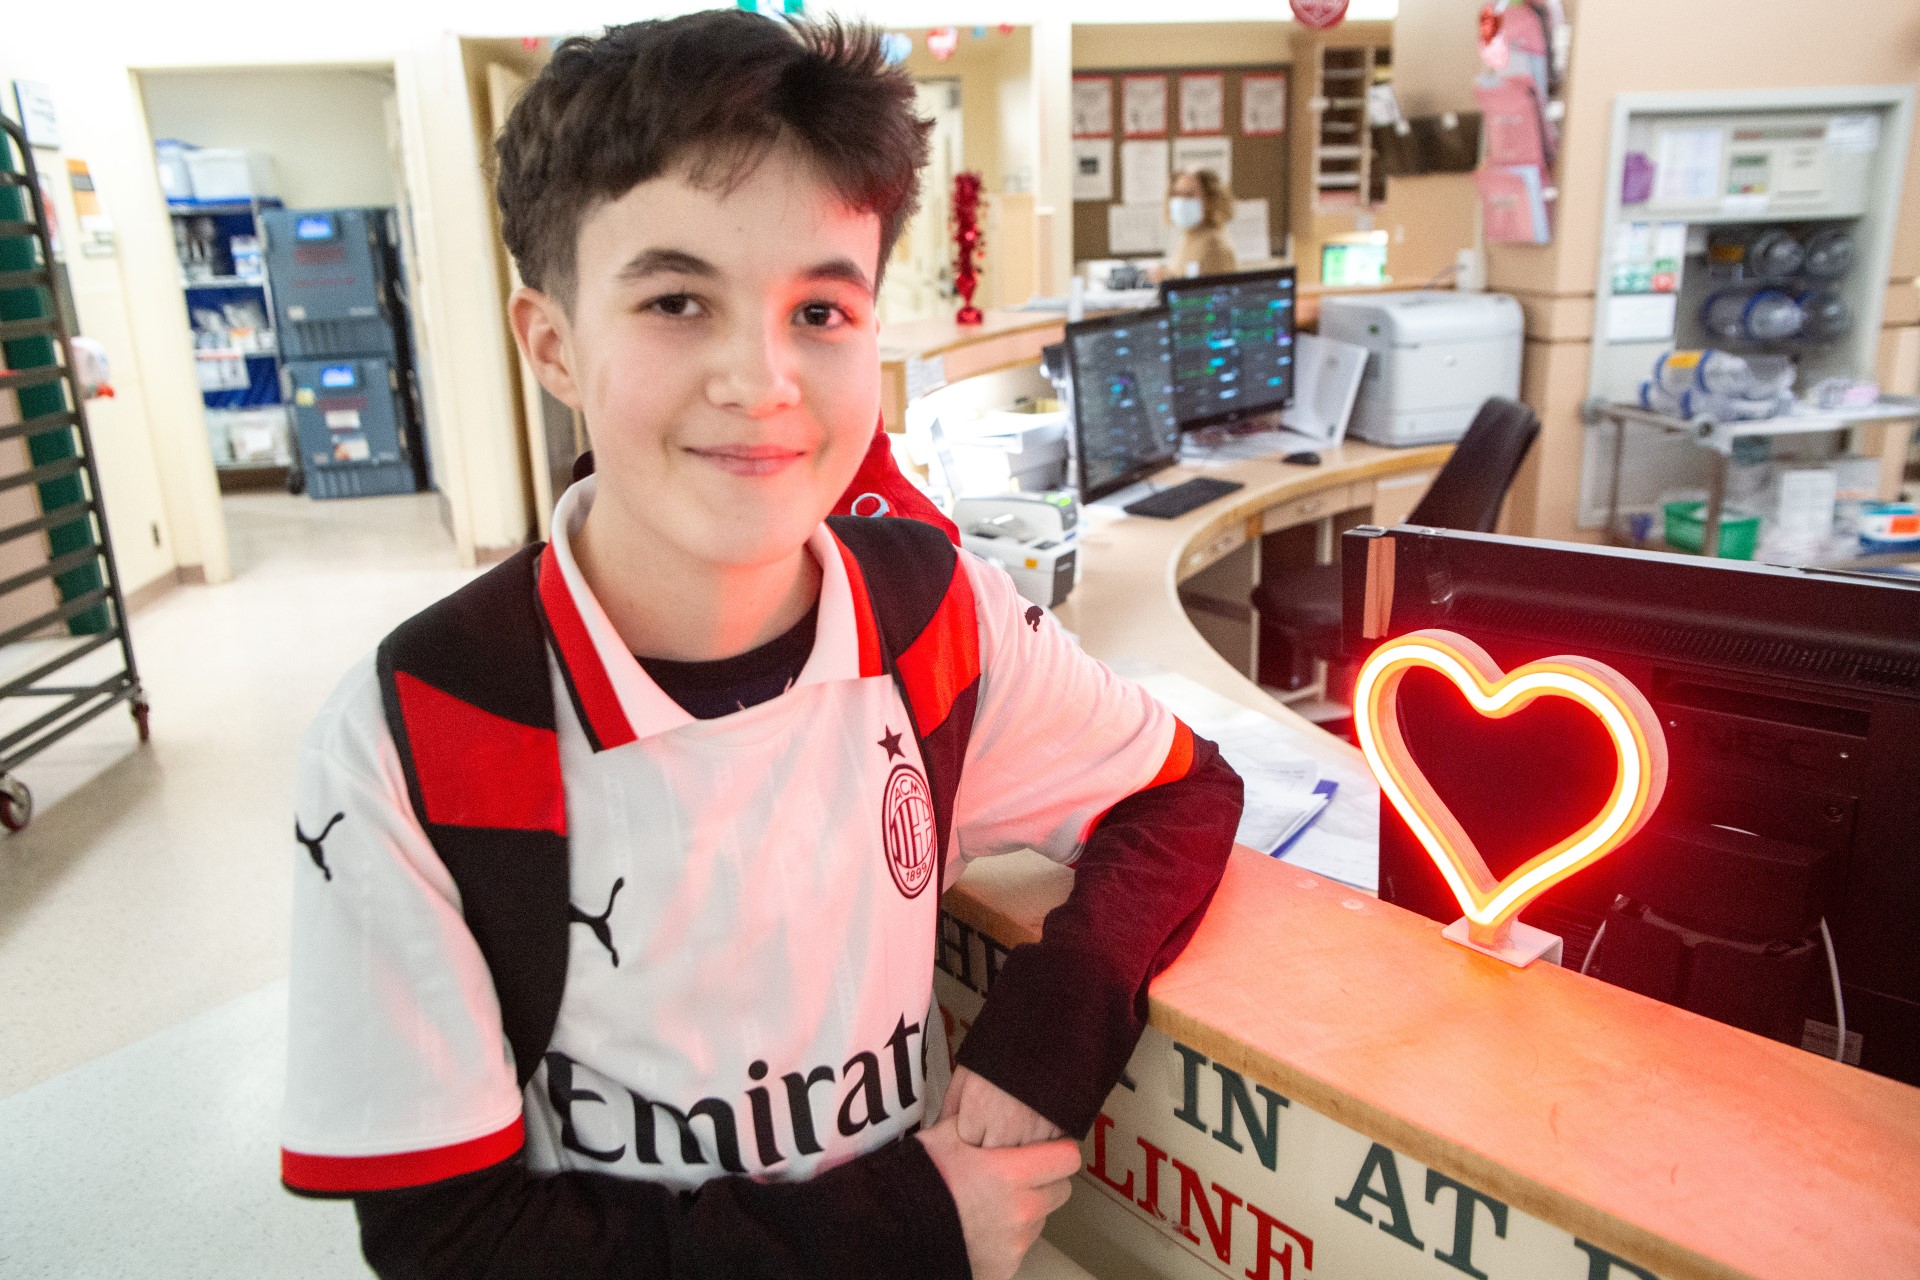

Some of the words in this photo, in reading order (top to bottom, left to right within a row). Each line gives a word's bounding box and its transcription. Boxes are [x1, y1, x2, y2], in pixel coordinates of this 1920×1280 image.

[894, 779, 921, 806] ACM
[905, 862, 928, 881] 1899
[546, 1010, 930, 1172] Emirat
[1173, 1040, 1291, 1173] IN
[1335, 1142, 1508, 1280] AT
